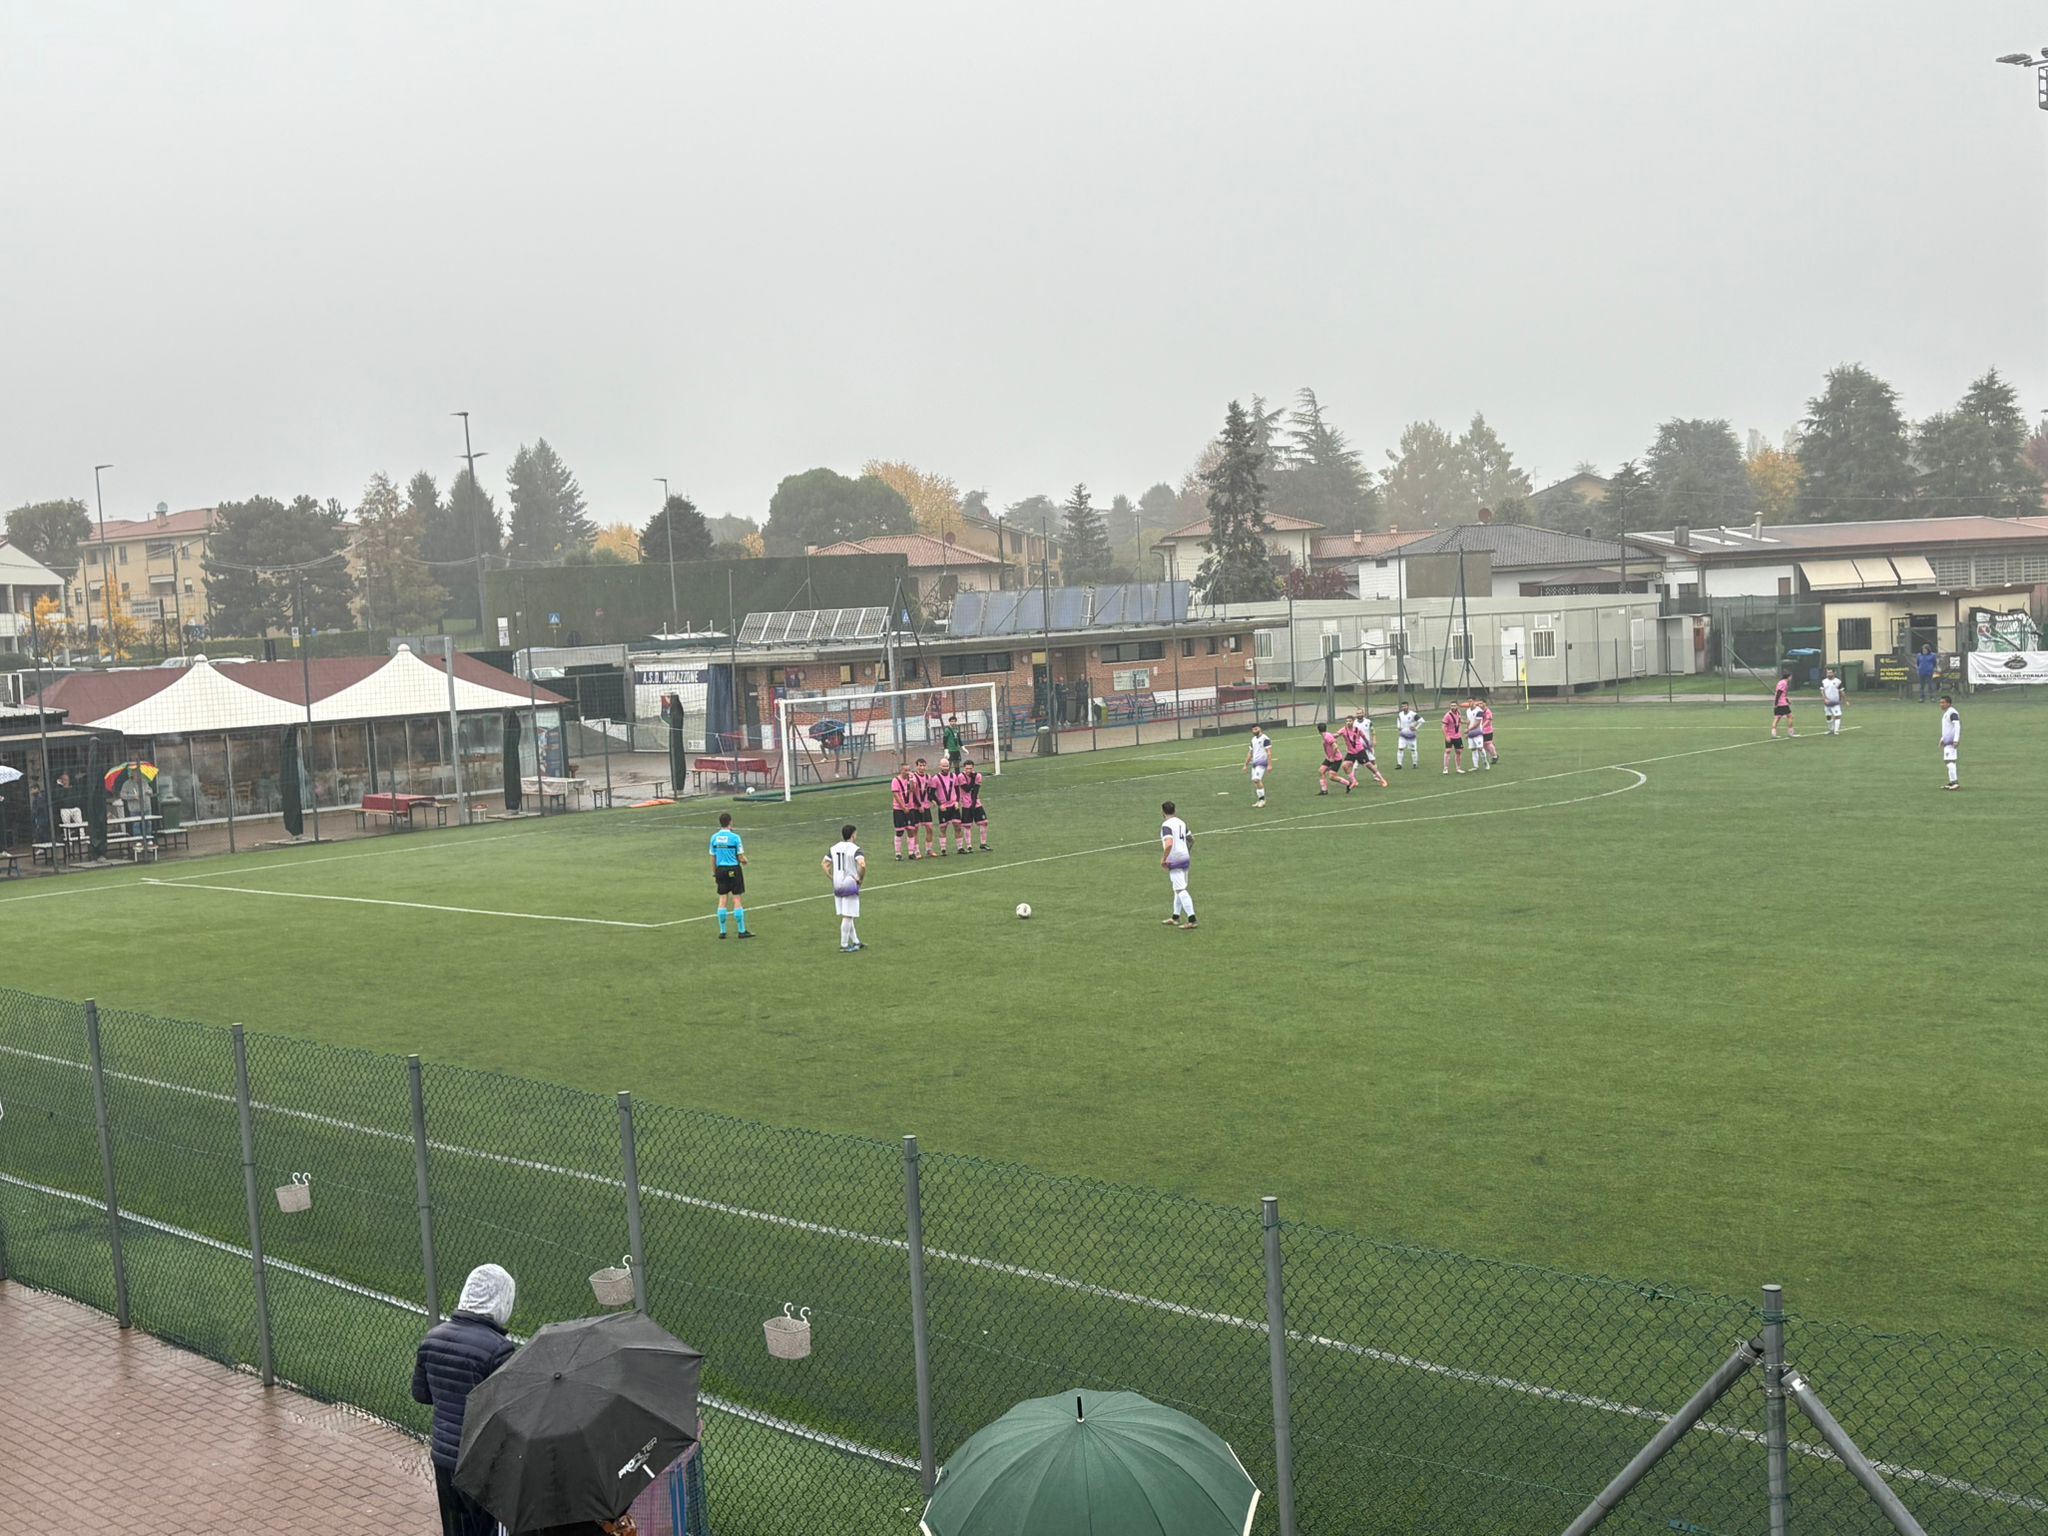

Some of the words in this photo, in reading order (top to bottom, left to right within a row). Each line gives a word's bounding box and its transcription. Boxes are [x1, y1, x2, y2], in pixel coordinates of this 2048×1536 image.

[642, 671, 661, 684] A.S.D.
[662, 670, 699, 683] MORAZZONE
[1179, 825, 1185, 842] 4
[836, 851, 845, 871] 11
